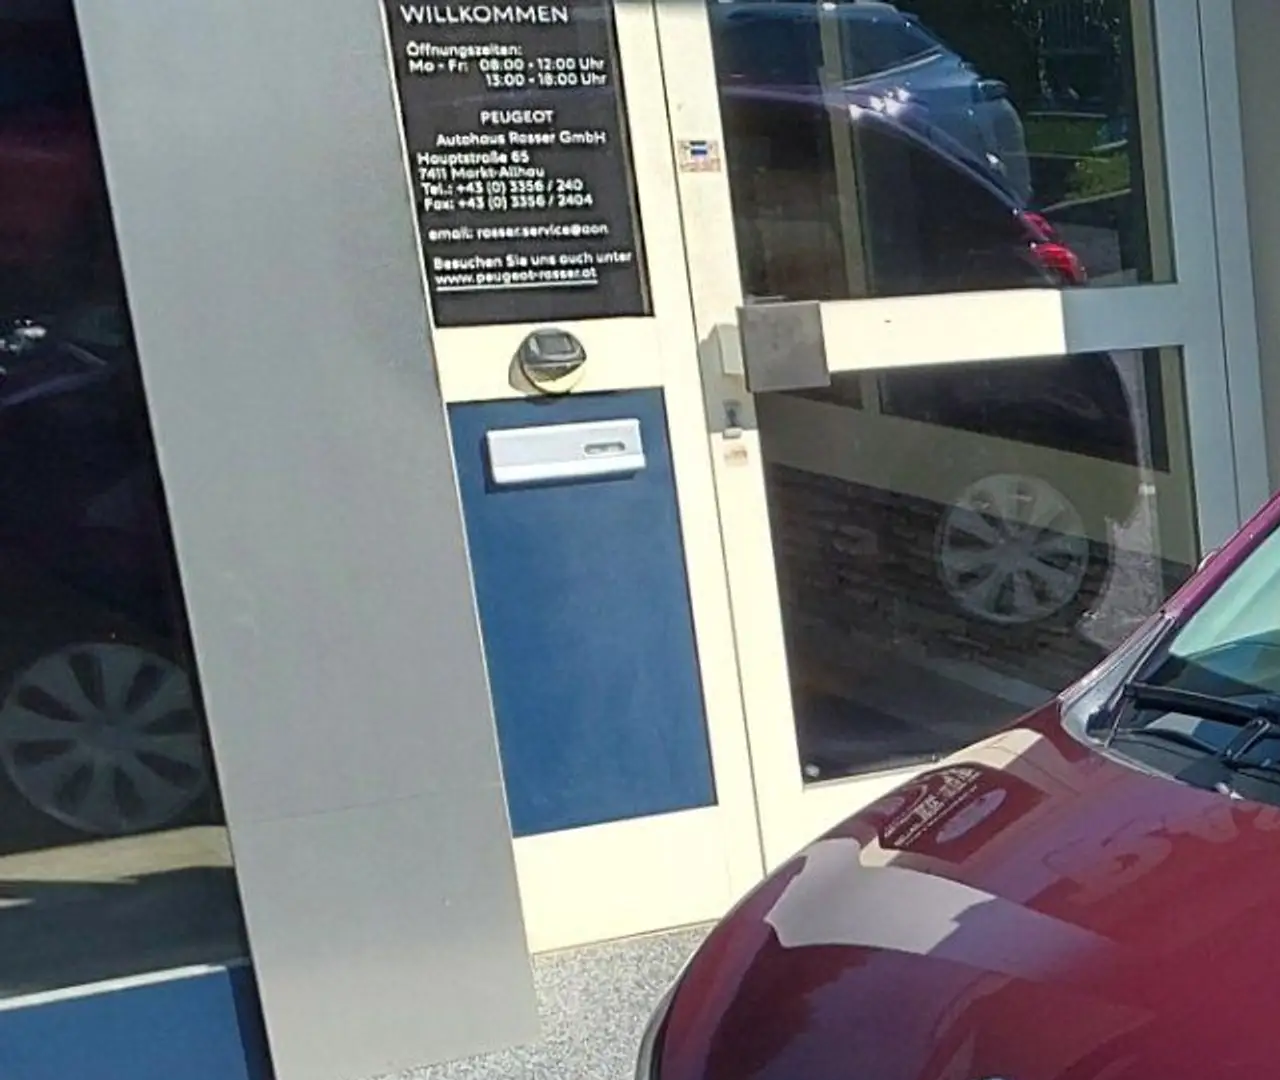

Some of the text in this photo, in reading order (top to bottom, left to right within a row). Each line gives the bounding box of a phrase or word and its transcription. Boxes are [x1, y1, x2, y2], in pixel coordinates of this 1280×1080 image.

[401, 5, 569, 25] WILLKOMMEN
[406, 40, 523, 58] Öffnungszeiten:
[408, 59, 435, 73] Mo
[479, 57, 524, 71] 08:00
[579, 57, 605, 70] Uhr
[485, 73, 525, 87] 13:00
[580, 72, 607, 86] Uhr
[480, 110, 555, 125] PEUGEOT
[436, 130, 607, 147] Autohaus Rasser GmbH
[416, 149, 530, 167] Hauptstraße 65
[418, 167, 447, 180] 7411
[455, 180, 483, 194] +43
[486, 180, 507, 196] (0)
[509, 179, 544, 193] 3356
[556, 178, 583, 191] 240
[424, 198, 454, 212] Fax:
[458, 196, 485, 210] +43
[488, 195, 507, 212] (0)
[511, 194, 545, 208] 3356
[428, 226, 473, 241] email:
[433, 251, 633, 270] Besuchen Sie uns auch unter
